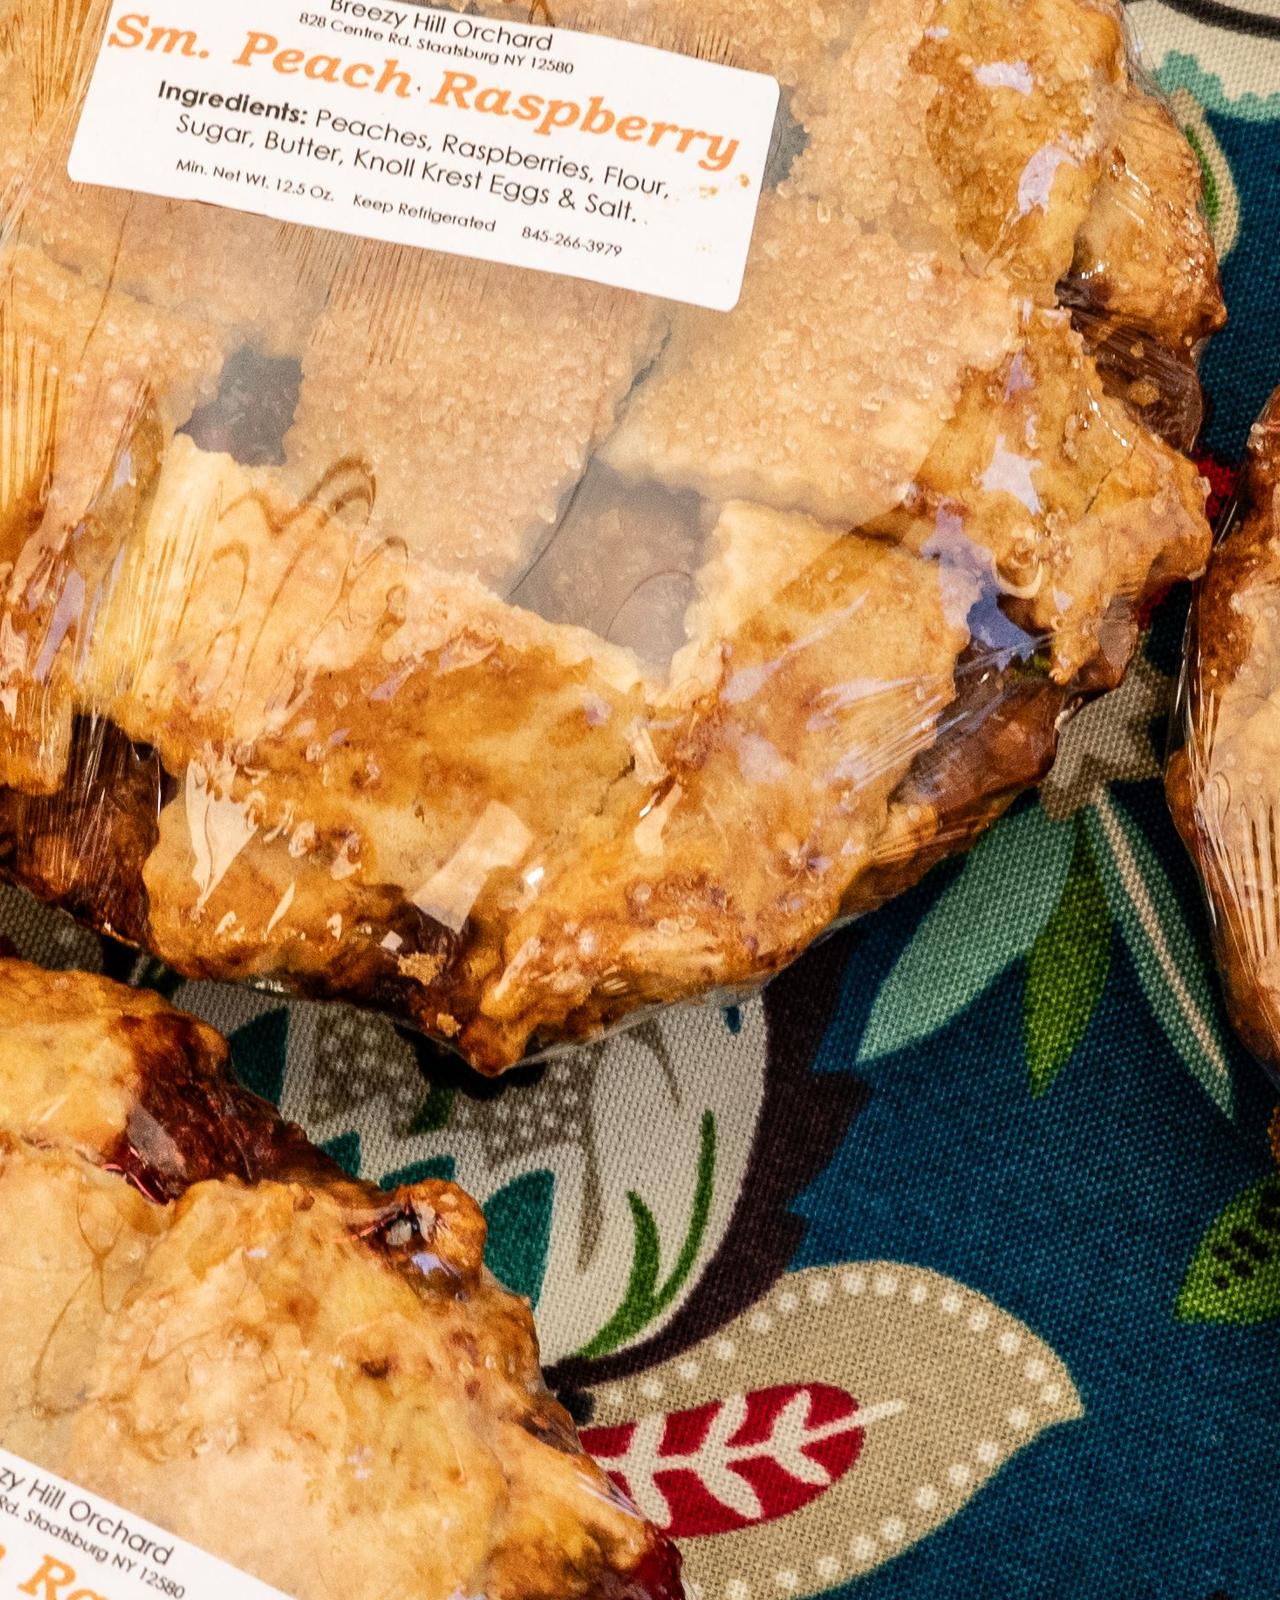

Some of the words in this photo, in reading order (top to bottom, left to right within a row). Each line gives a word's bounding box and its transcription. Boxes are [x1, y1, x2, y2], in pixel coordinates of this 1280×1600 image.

[298, 12, 327, 28] 828
[330, 20, 384, 41] Centre
[416, 38, 500, 65] Staatsburg
[503, 53, 526, 67] NY
[531, 56, 574, 74] 12580
[413, 12, 447, 34] Hill
[453, 19, 554, 51] Orchard
[107, 12, 210, 60] Sm.
[233, 30, 412, 99] Peach
[430, 69, 740, 173] Raspberry
[158, 80, 308, 125] Ingredients:
[316, 109, 433, 151] Peaches,
[443, 134, 595, 183] Raspberries,
[604, 166, 669, 199] Flour,
[176, 114, 255, 147] Sugar,
[265, 131, 344, 165] Butter,
[353, 148, 416, 178] Knoll
[421, 161, 483, 190] Krest
[489, 173, 550, 206] Eggs
[557, 188, 576, 211] &
[584, 193, 637, 223] Salt.
[212, 165, 241, 183] Net
[276, 177, 306, 196] 12.5
[353, 193, 394, 215] Keep
[398, 202, 497, 232] Refrigerated
[521, 226, 623, 257] 845-266-3979
[23, 1509, 109, 1563] Staatsburg
[111, 1553, 137, 1573] NY
[139, 1567, 186, 1600] 12580
[27, 1478, 67, 1511] Hill
[68, 1500, 175, 1566] Orchard
